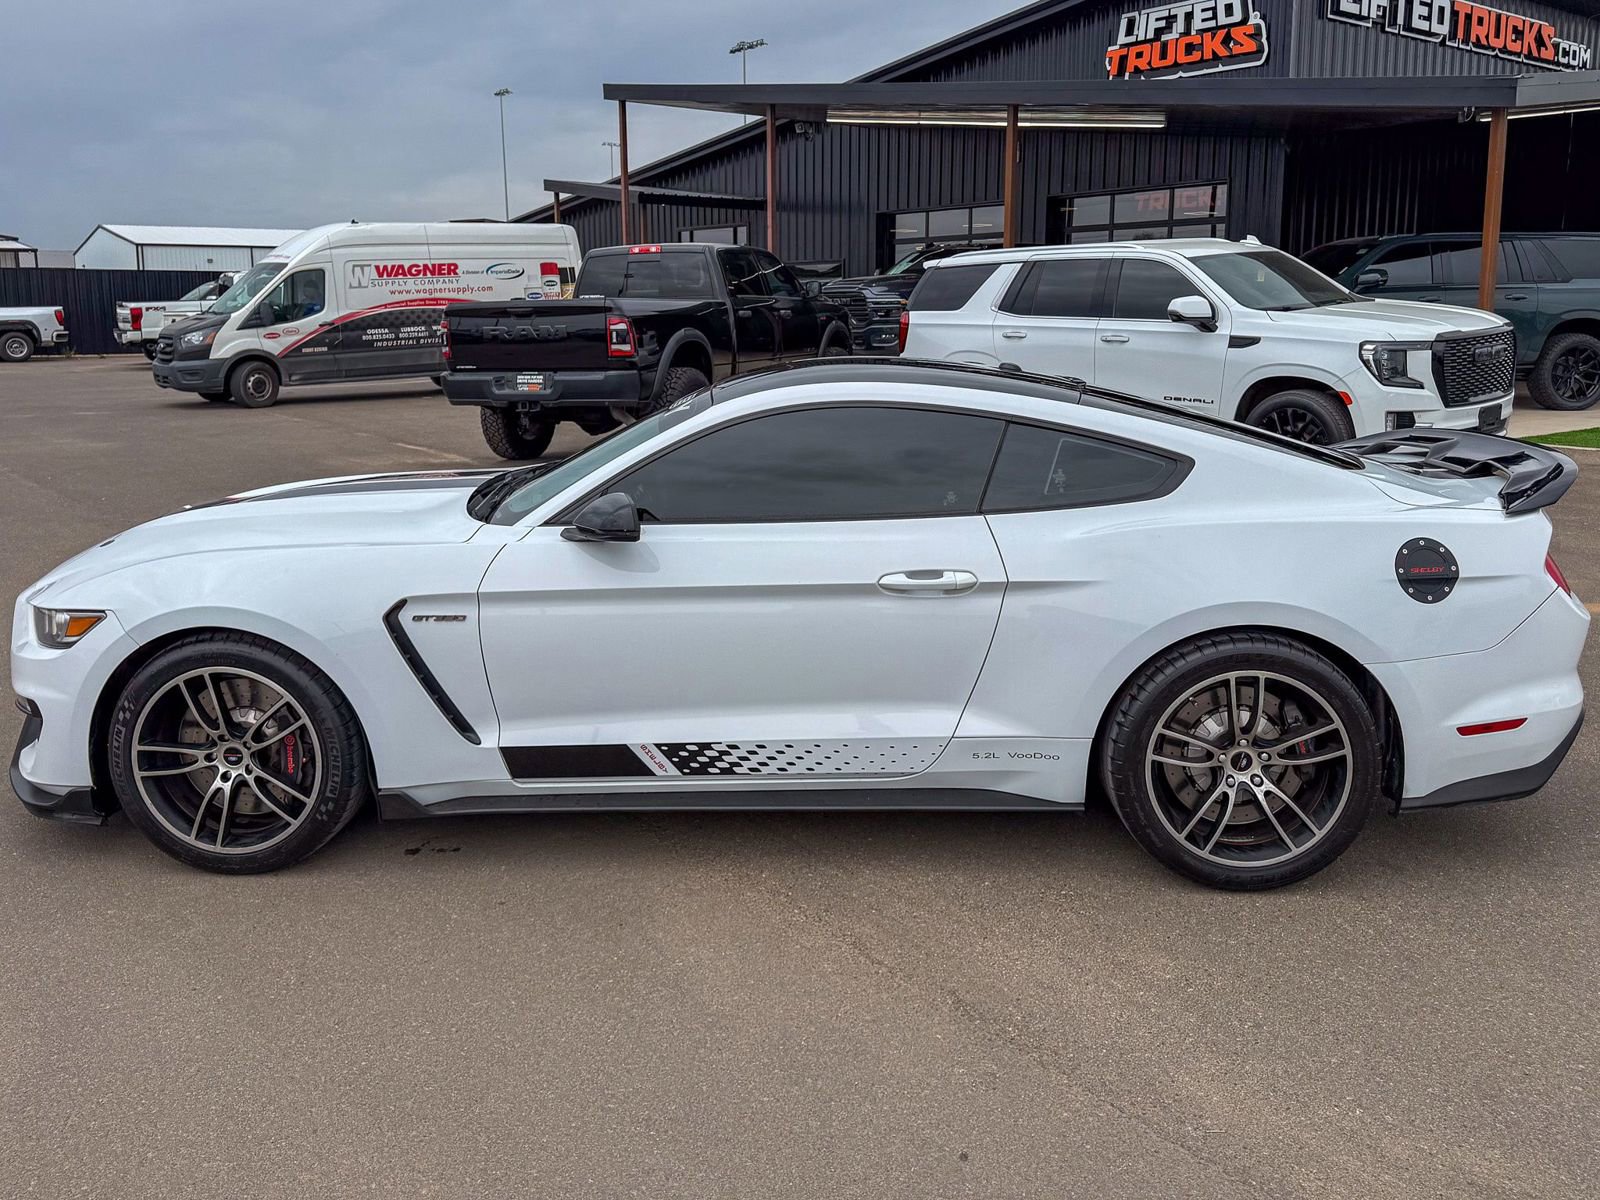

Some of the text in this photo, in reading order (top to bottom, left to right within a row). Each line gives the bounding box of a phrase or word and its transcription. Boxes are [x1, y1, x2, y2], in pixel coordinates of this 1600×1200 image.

[1117, 0, 1243, 45] LIFTED
[1106, 25, 1258, 76] TRUCKS
[374, 263, 459, 278] WAGNER
[414, 278, 460, 286] COMPANY
[389, 284, 493, 296] www.wagnersupply.com
[482, 326, 567, 340] RAM
[374, 339, 416, 347] INDUSTRIAL
[1163, 396, 1214, 404] DENALI
[640, 744, 668, 773] SHELBY
[972, 752, 1060, 761] 5.2L VooDoo
